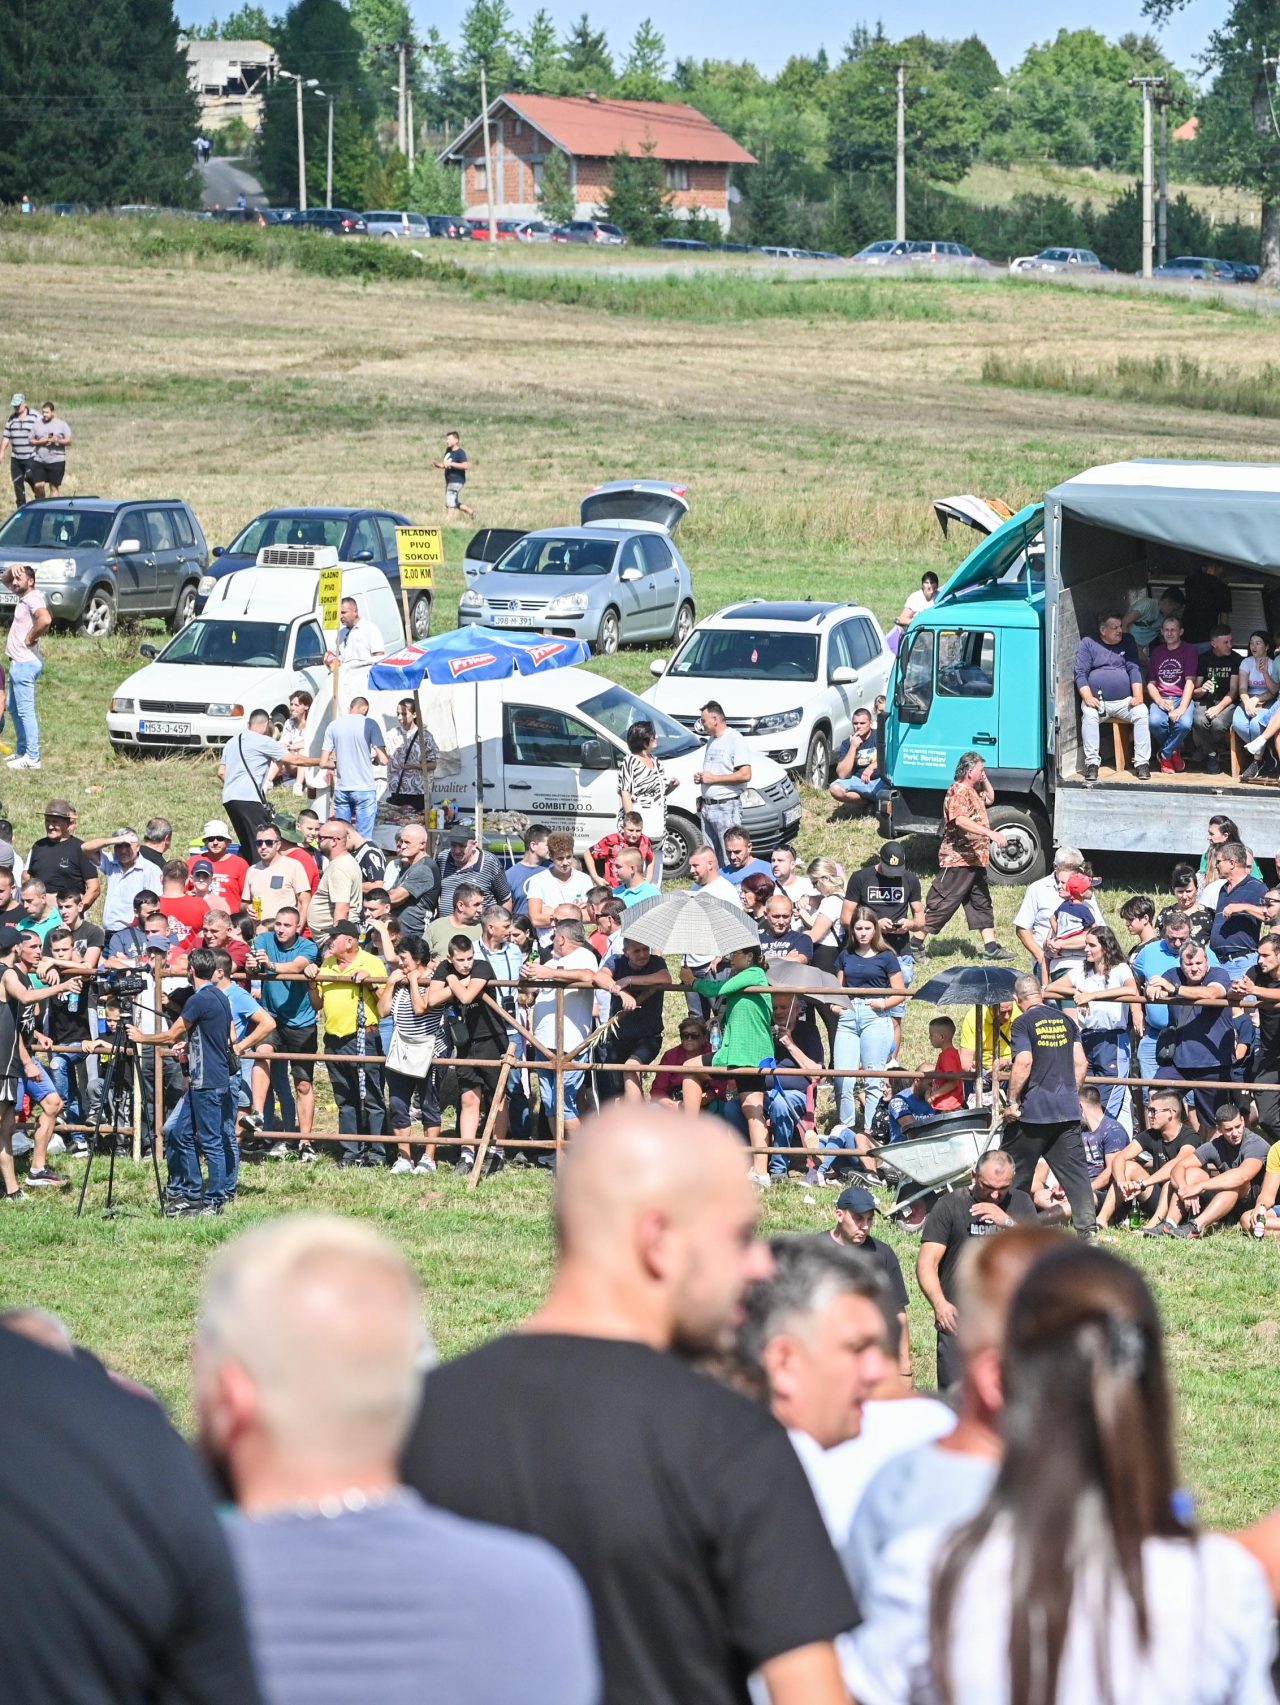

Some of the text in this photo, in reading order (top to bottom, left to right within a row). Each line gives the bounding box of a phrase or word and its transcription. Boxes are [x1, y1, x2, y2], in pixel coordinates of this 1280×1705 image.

[401, 529, 437, 537] HLADNO
[410, 541, 431, 549] PIVO
[404, 568, 432, 581] 2,00 KM
[320, 596, 338, 604] SOKOVI
[495, 617, 533, 626] J98-M-391
[145, 722, 190, 734] M53-J-457
[431, 781, 467, 793] kvalitet
[532, 802, 594, 811] GOMBIT D.O.O.
[870, 890, 891, 899] FILA
